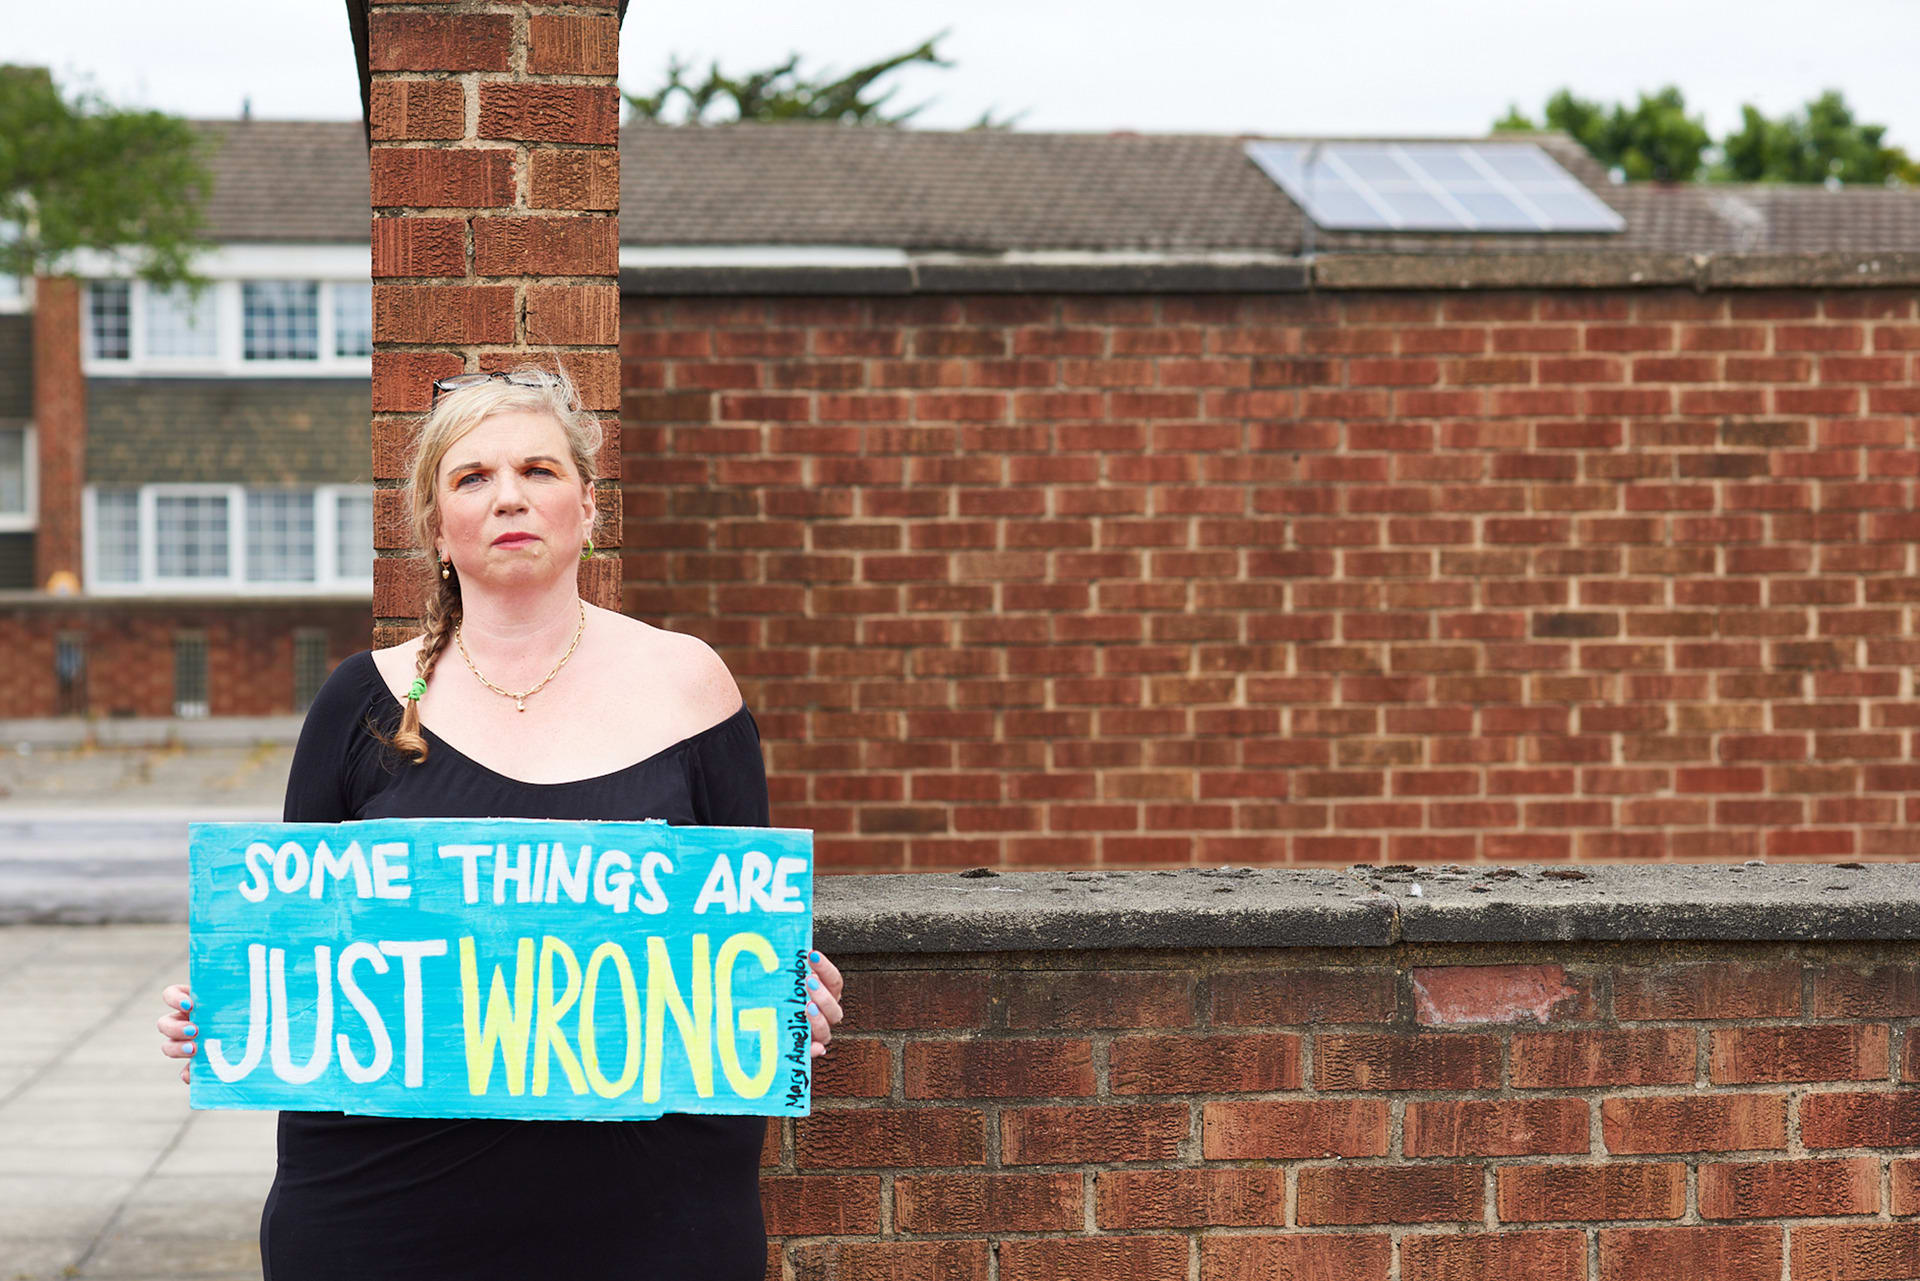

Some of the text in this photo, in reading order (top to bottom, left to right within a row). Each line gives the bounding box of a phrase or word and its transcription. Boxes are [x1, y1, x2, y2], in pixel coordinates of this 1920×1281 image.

[238, 840, 808, 914] SOME THINGS ARE
[206, 932, 779, 1103] JUST WRONG
[784, 949, 809, 1109] Mary Amelia London
